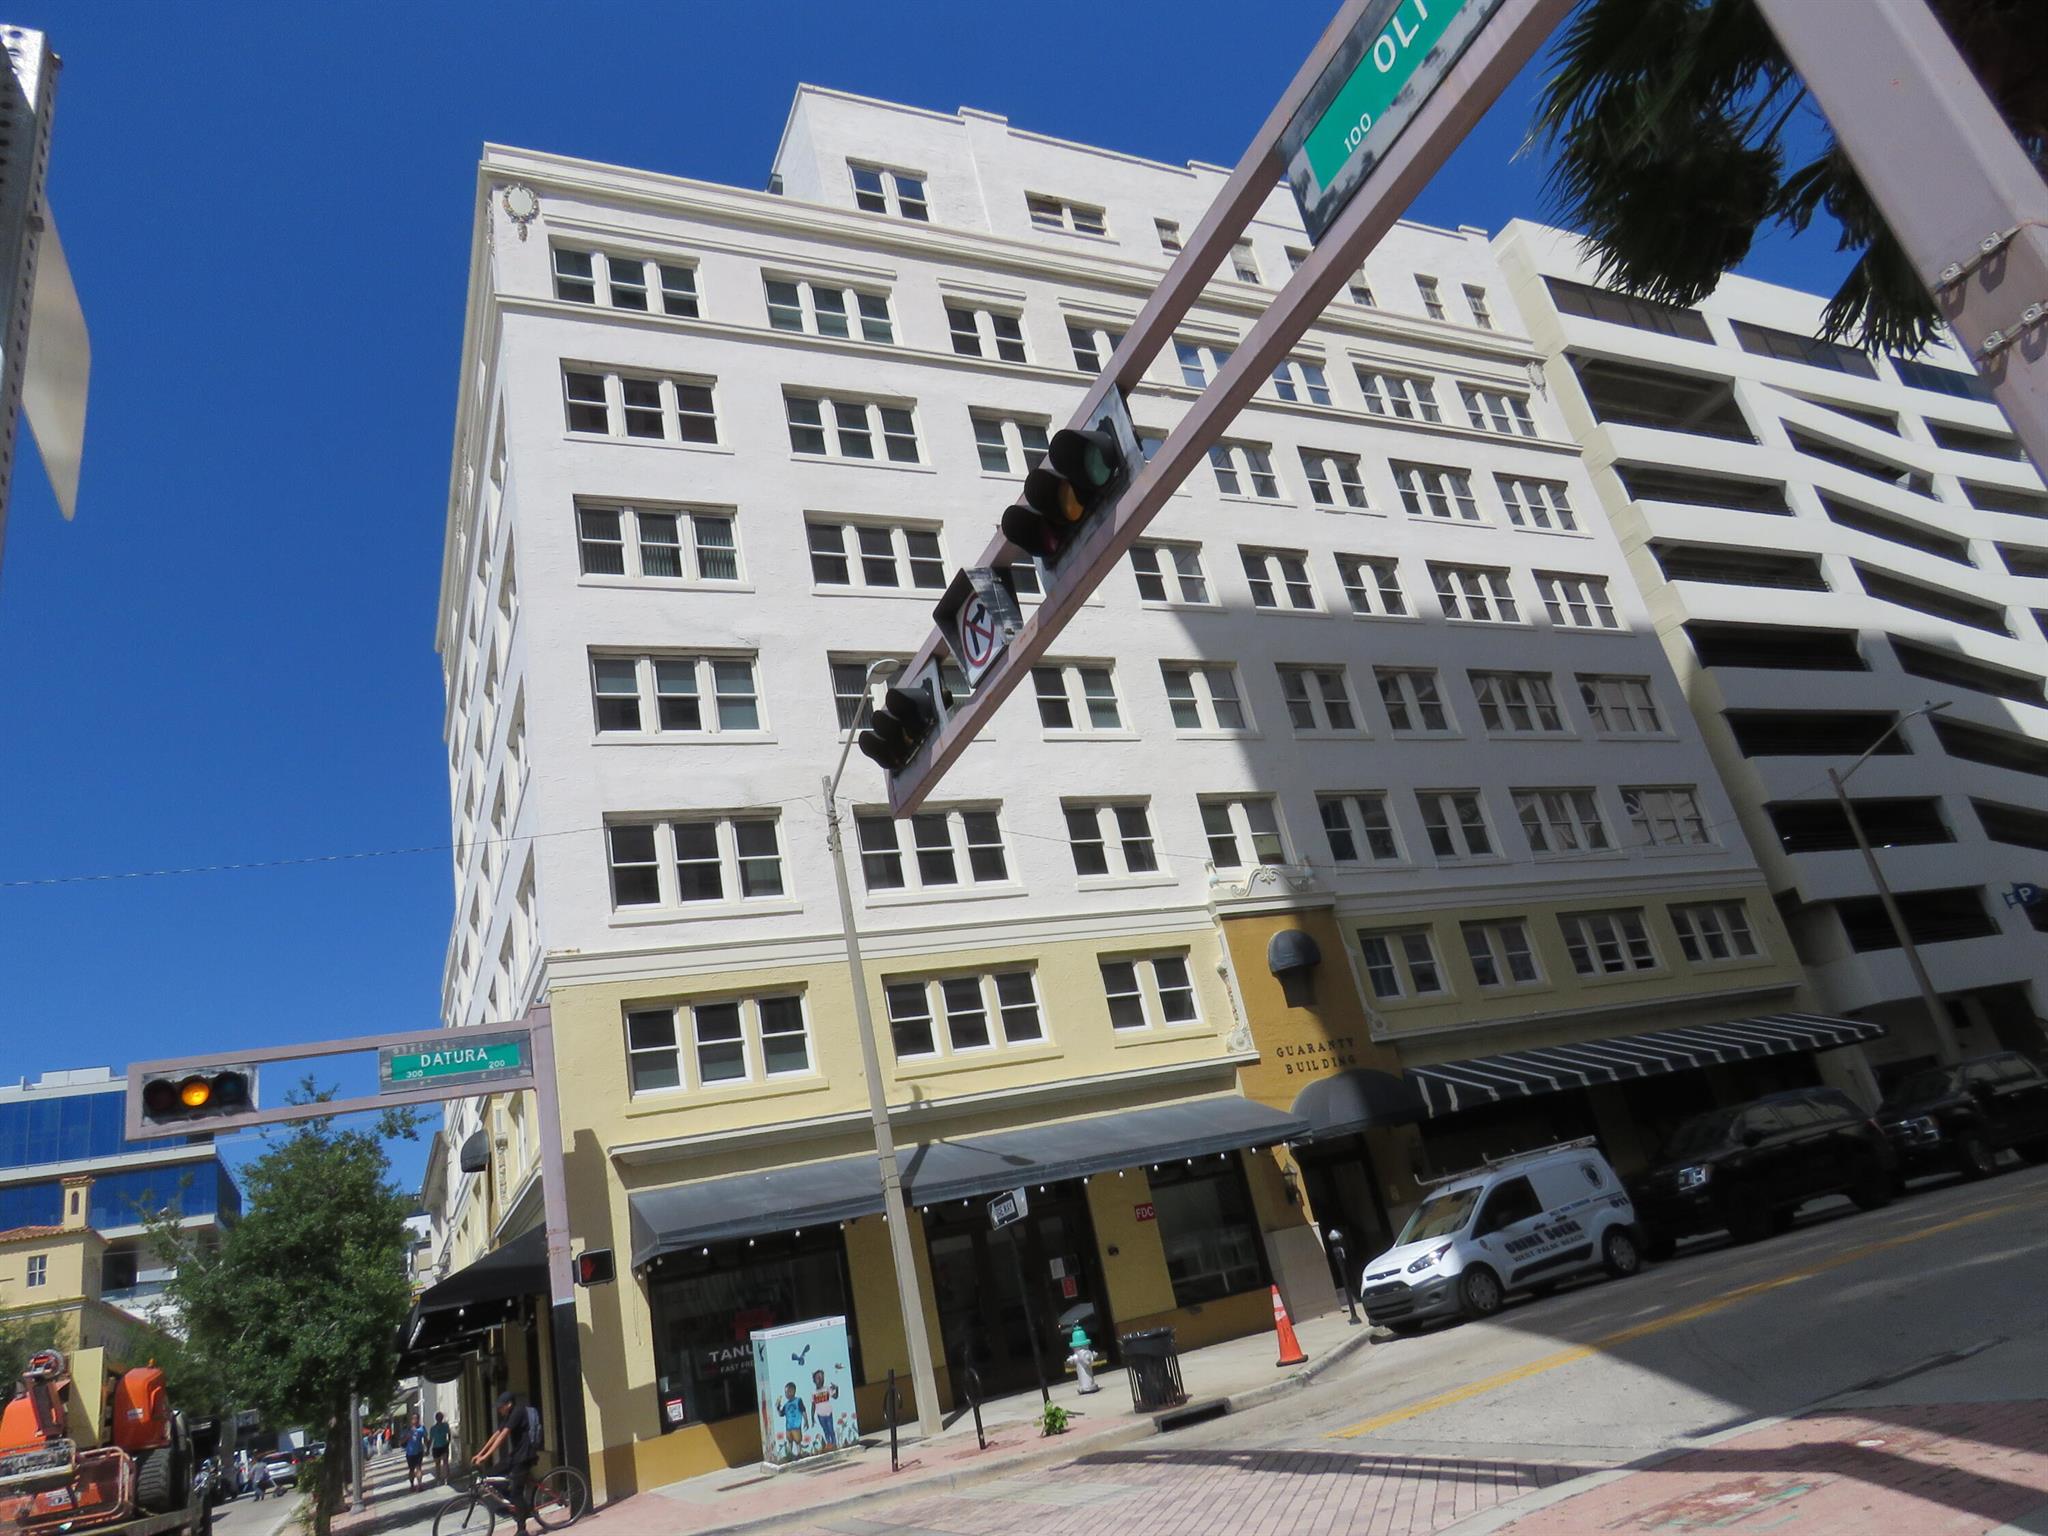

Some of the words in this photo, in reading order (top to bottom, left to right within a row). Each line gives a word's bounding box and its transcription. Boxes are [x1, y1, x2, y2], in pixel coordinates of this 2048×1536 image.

[1343, 112, 1372, 152] 100
[1276, 1037, 1353, 1058] GUARANTY
[421, 1048, 488, 1067] DATURA
[489, 1059, 506, 1069] 200
[1286, 1054, 1357, 1075] BUILDING
[406, 1069, 424, 1078] 300
[1135, 1206, 1154, 1219] FDC
[720, 1365, 739, 1374] FAST
